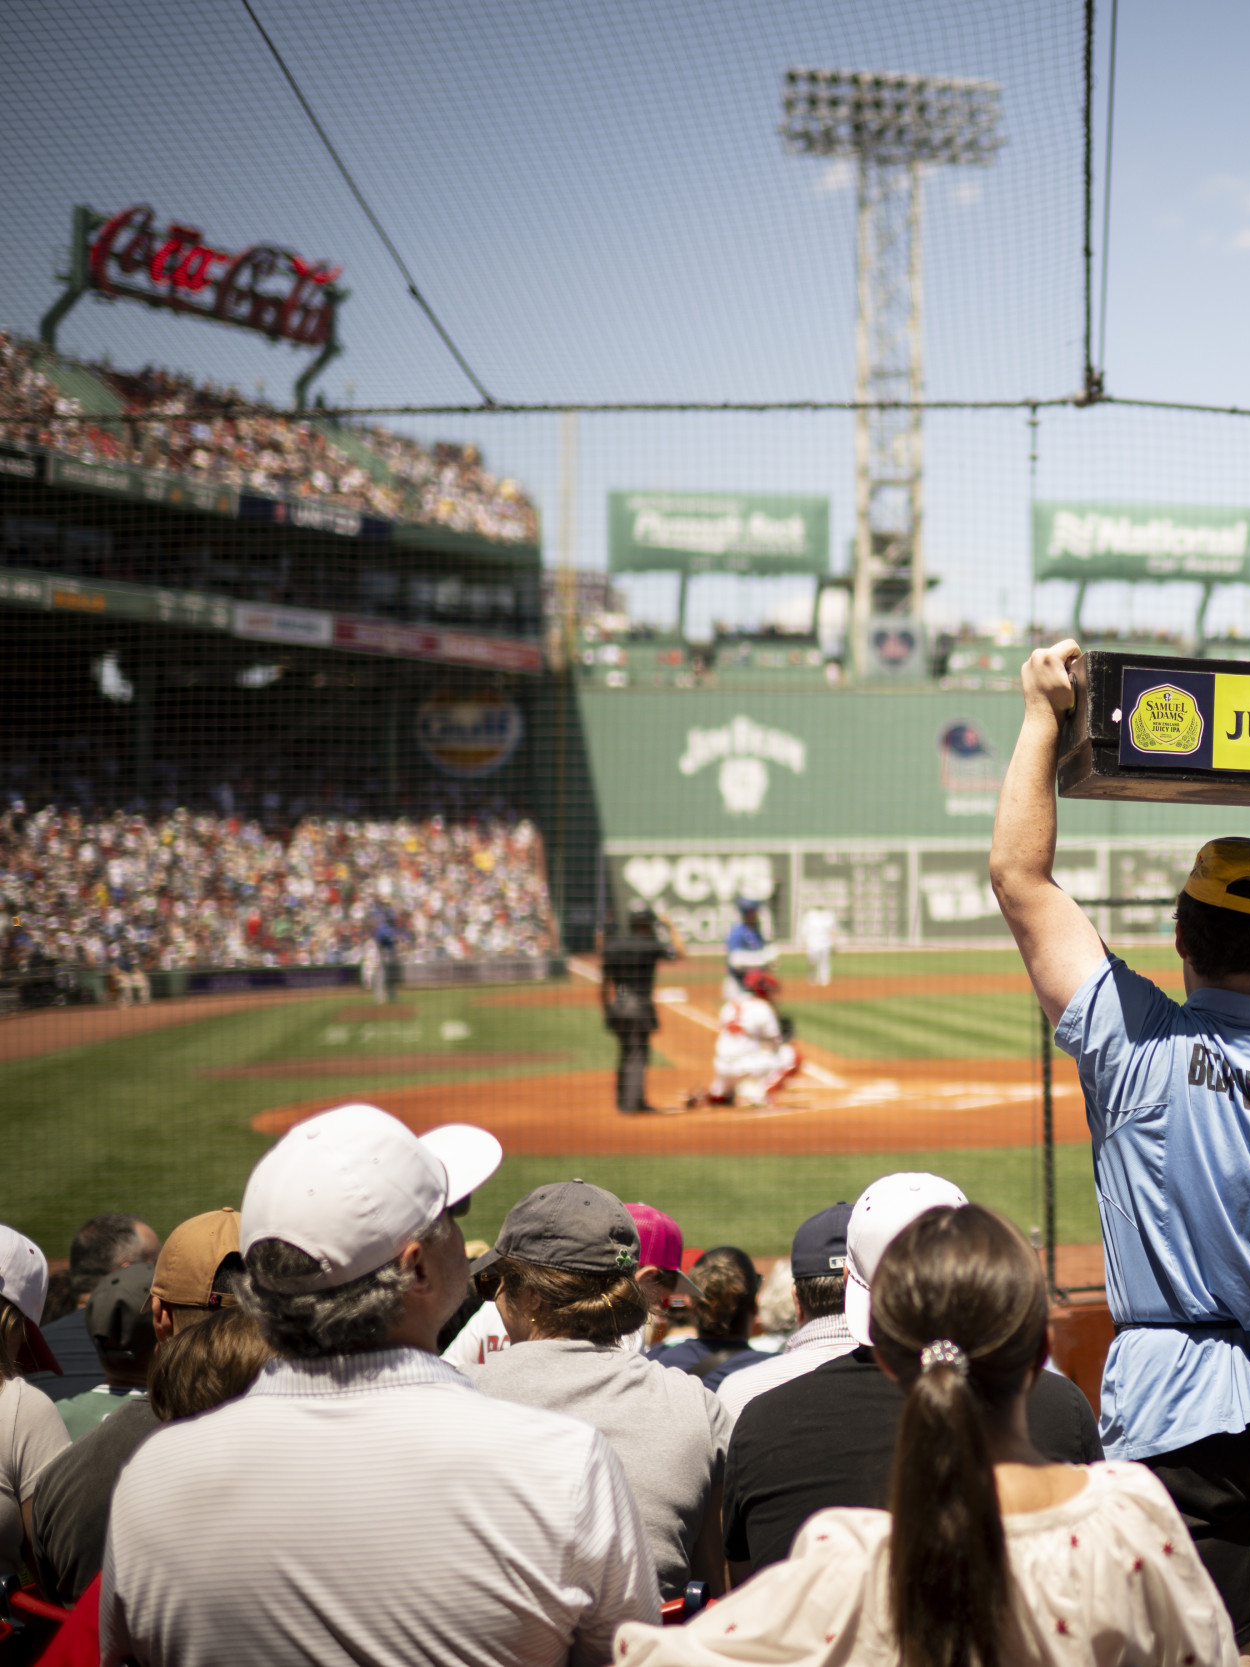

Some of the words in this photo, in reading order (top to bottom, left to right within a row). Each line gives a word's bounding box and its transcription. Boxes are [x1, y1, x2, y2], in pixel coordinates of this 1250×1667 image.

[1098, 515, 1248, 557] National
[1146, 700, 1188, 713] SAMUEL
[1149, 711, 1184, 722] ADAMS
[674, 855, 773, 901] CVS
